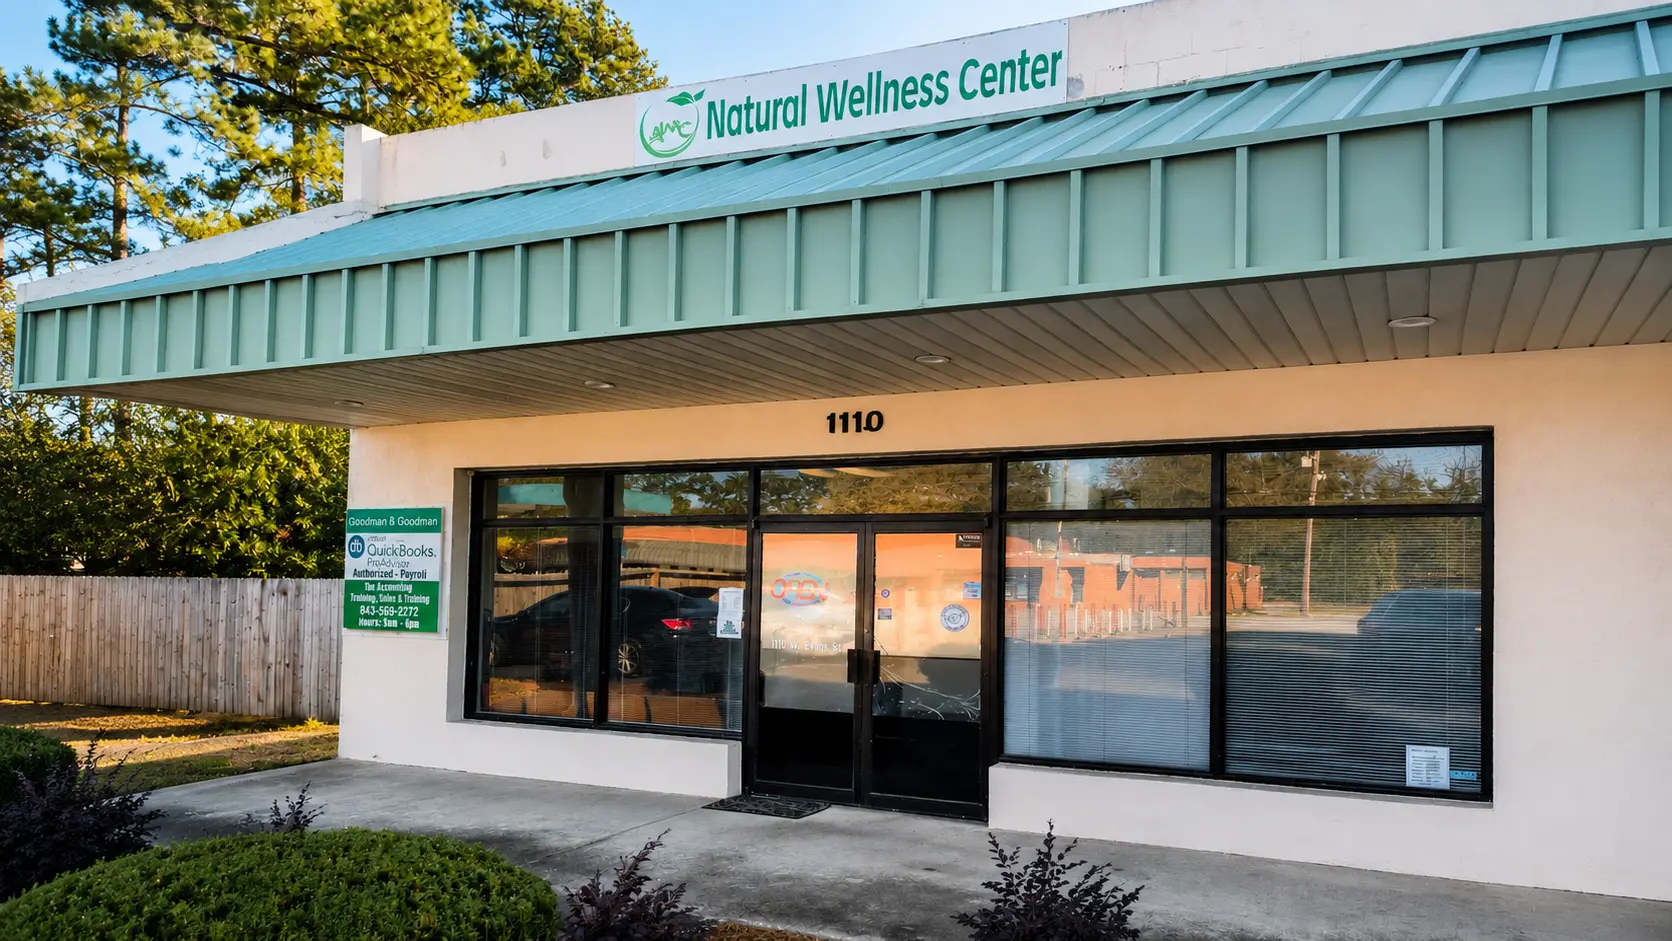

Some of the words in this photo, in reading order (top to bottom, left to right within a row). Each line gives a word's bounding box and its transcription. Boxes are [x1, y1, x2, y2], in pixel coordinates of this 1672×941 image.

[707, 84, 807, 140] Natural
[817, 70, 950, 123] Wellness
[958, 48, 1063, 101] Center
[826, 410, 884, 433] 1110
[348, 516, 387, 526] Goodman
[389, 516, 395, 525] &
[397, 516, 438, 526] Goodman
[353, 568, 393, 578] Authorized
[770, 578, 829, 601] OPEN
